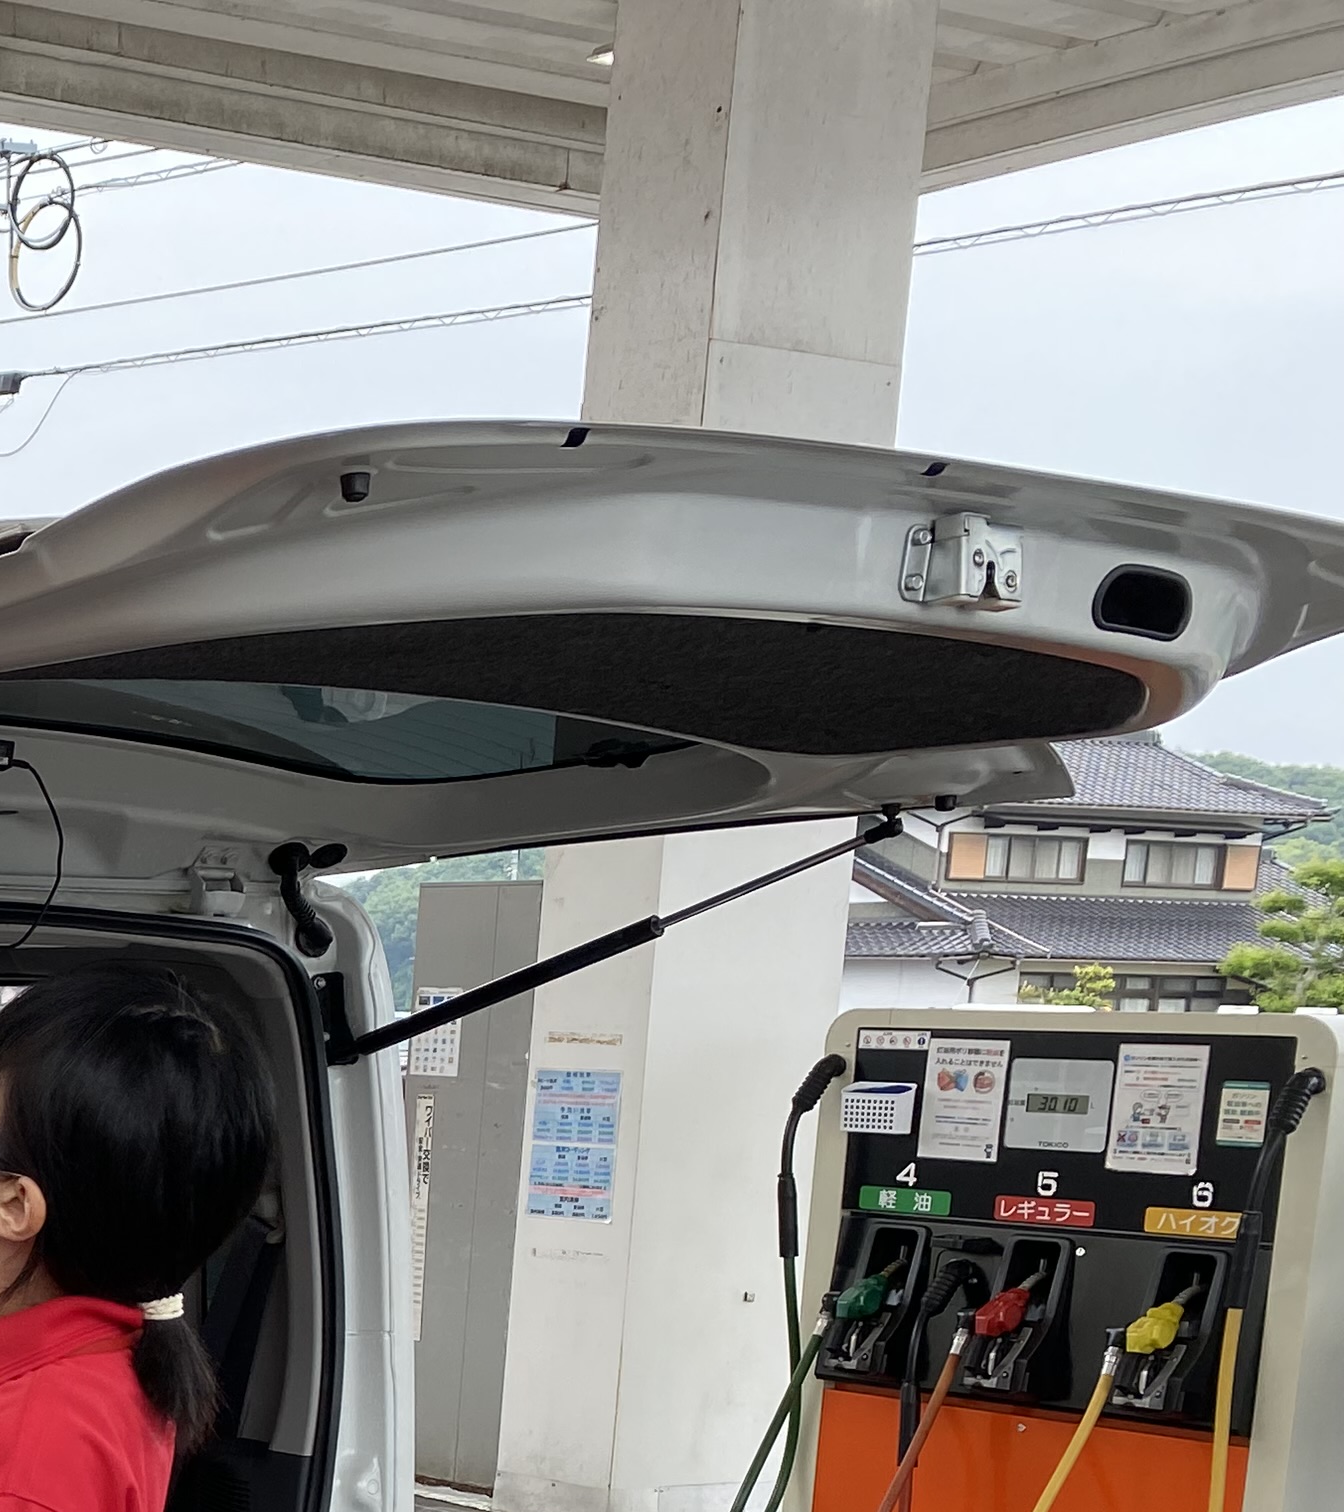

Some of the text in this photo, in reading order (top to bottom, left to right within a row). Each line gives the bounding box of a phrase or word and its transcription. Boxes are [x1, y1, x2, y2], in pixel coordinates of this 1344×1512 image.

[895, 1162, 918, 1188] 4
[1037, 1170, 1060, 1197] 5
[877, 1189, 932, 1212] 軽油
[1192, 1182, 1215, 1208] 6
[999, 1199, 1091, 1223] レギュラー
[1157, 1211, 1241, 1236] ハイオク
